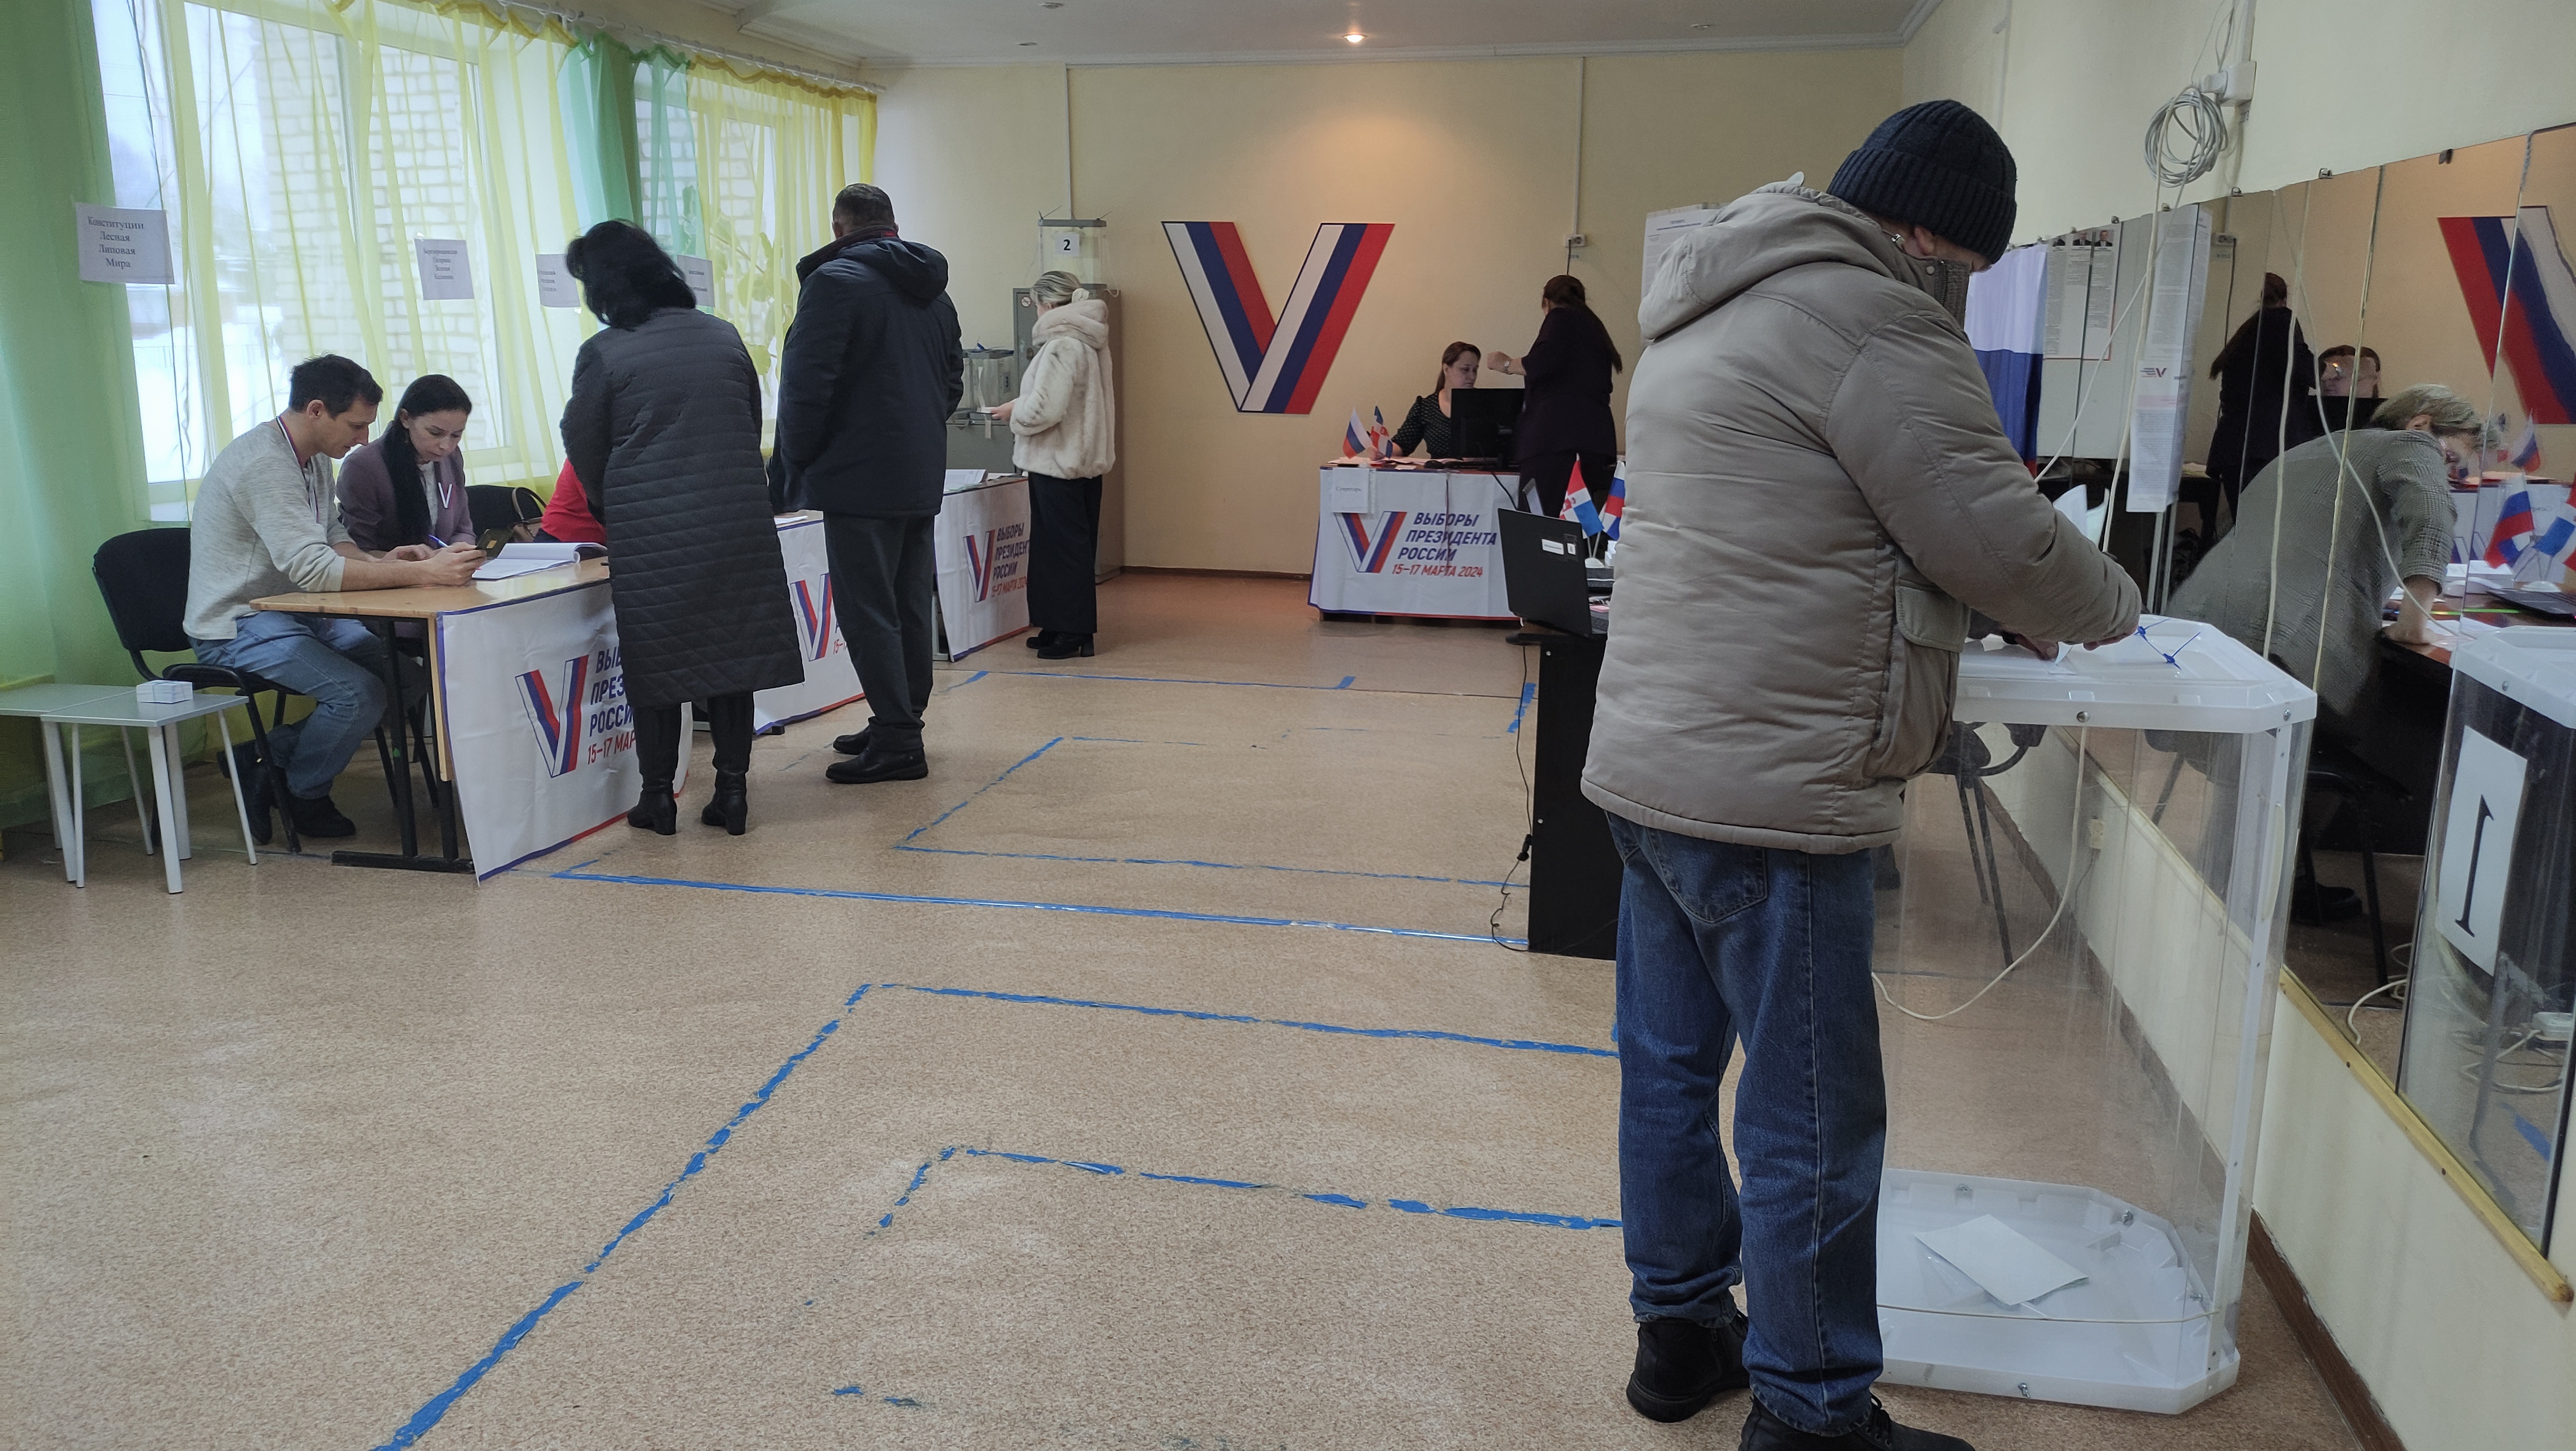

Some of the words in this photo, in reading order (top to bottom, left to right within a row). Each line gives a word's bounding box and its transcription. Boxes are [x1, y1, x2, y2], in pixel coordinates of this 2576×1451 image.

[99, 231, 130, 241] Лесная
[99, 244, 136, 255] Липовая
[1063, 239, 1071, 251] 2
[106, 258, 131, 269] Мира
[1413, 512, 1480, 527] ВЫБОРЫ
[997, 523, 1024, 542] ВЫБОРЫ
[1405, 530, 1497, 546] ПРЕЗИДЕНТА
[1397, 547, 1457, 561] РОССИИ
[993, 561, 1018, 581] РОССИИ
[1421, 564, 1456, 577] МАРТА
[1457, 566, 1484, 577] 2024
[596, 646, 622, 673] ВЫБ
[589, 703, 633, 737] РОССИ
[613, 730, 636, 754] МАР
